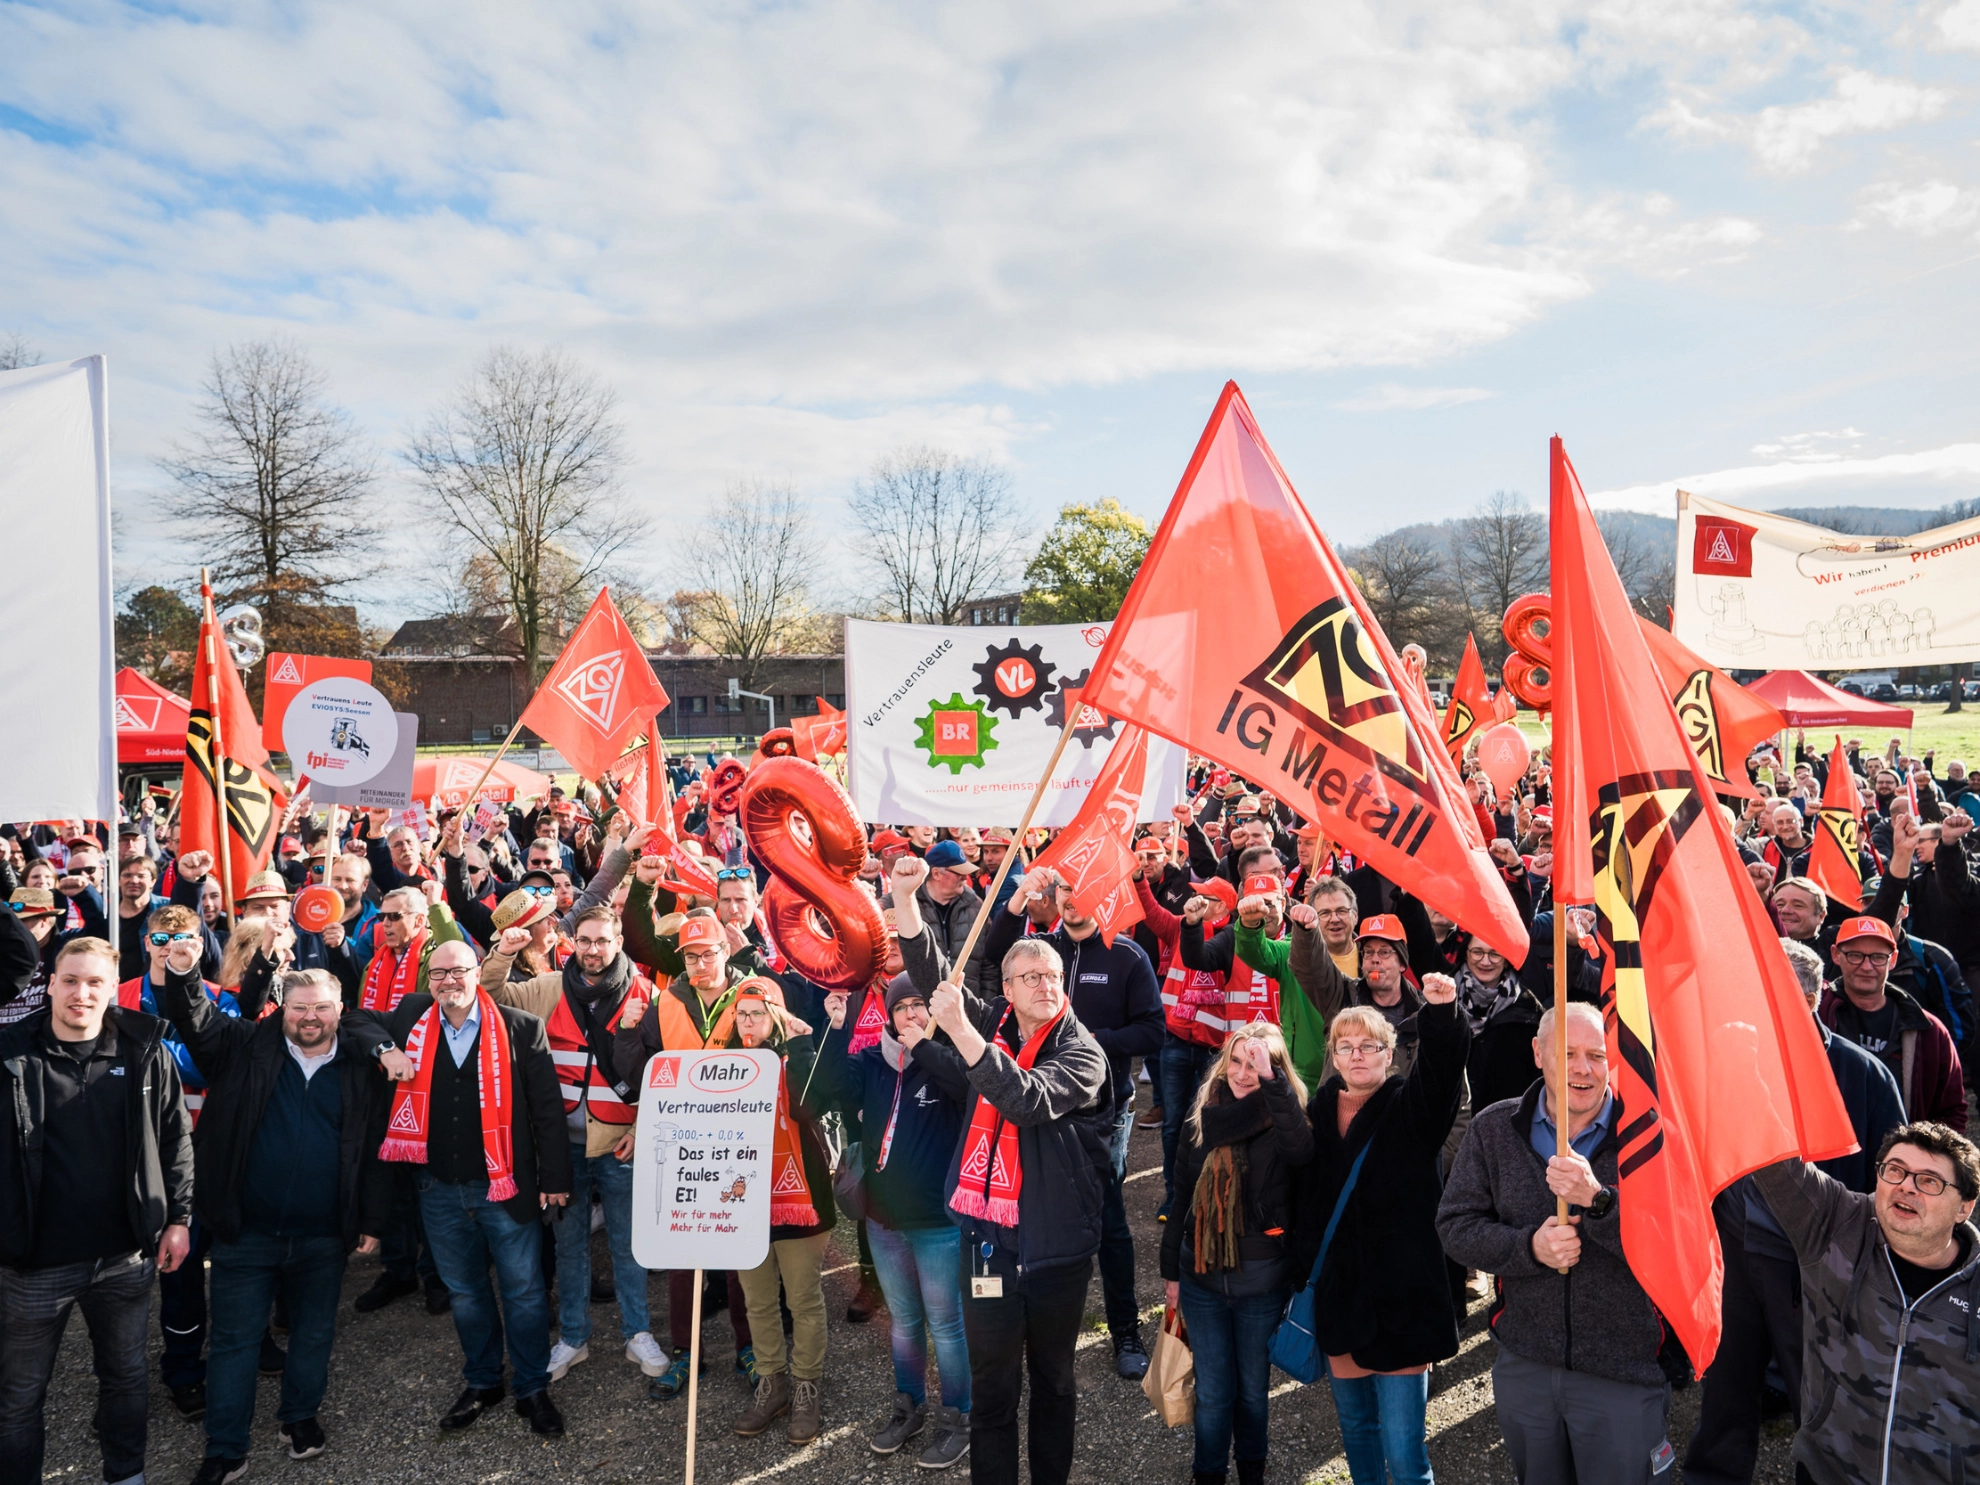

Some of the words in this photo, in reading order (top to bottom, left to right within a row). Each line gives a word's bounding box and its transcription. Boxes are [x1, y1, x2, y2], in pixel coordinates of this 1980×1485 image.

[1812, 571, 1844, 585] Wir
[1848, 565, 1882, 578] haben
[863, 637, 954, 728] Vertrauensleute
[995, 663, 1036, 693] VL
[312, 694, 351, 705] Vertrauens
[352, 698, 373, 707] Leute
[941, 722, 971, 741] BR
[145, 747, 187, 756] Süd-Nieder
[307, 750, 329, 769] fpi
[1216, 690, 1277, 756] IG
[1280, 726, 1438, 858] Metall
[360, 788, 406, 798] MITEINANDER
[973, 782, 1042, 796] gemeinsa
[1051, 776, 1082, 790] läuft
[360, 795, 374, 804] FÜR
[375, 796, 406, 806] MORGEN
[700, 1063, 749, 1081] Mahr
[658, 1099, 773, 1114] Vertrauensleute
[718, 1129, 734, 1142] 0,0
[736, 1131, 744, 1141] %
[679, 1146, 704, 1161] Das
[711, 1147, 731, 1161] ist
[736, 1147, 757, 1161] ein
[676, 1166, 720, 1182] faules
[676, 1187, 698, 1203] EI!
[671, 1210, 688, 1220] Wir
[691, 1209, 706, 1220] für
[709, 1210, 733, 1220] mehr
[670, 1223, 693, 1233] Mehr
[697, 1222, 712, 1233] für
[715, 1223, 739, 1233] Mahr
